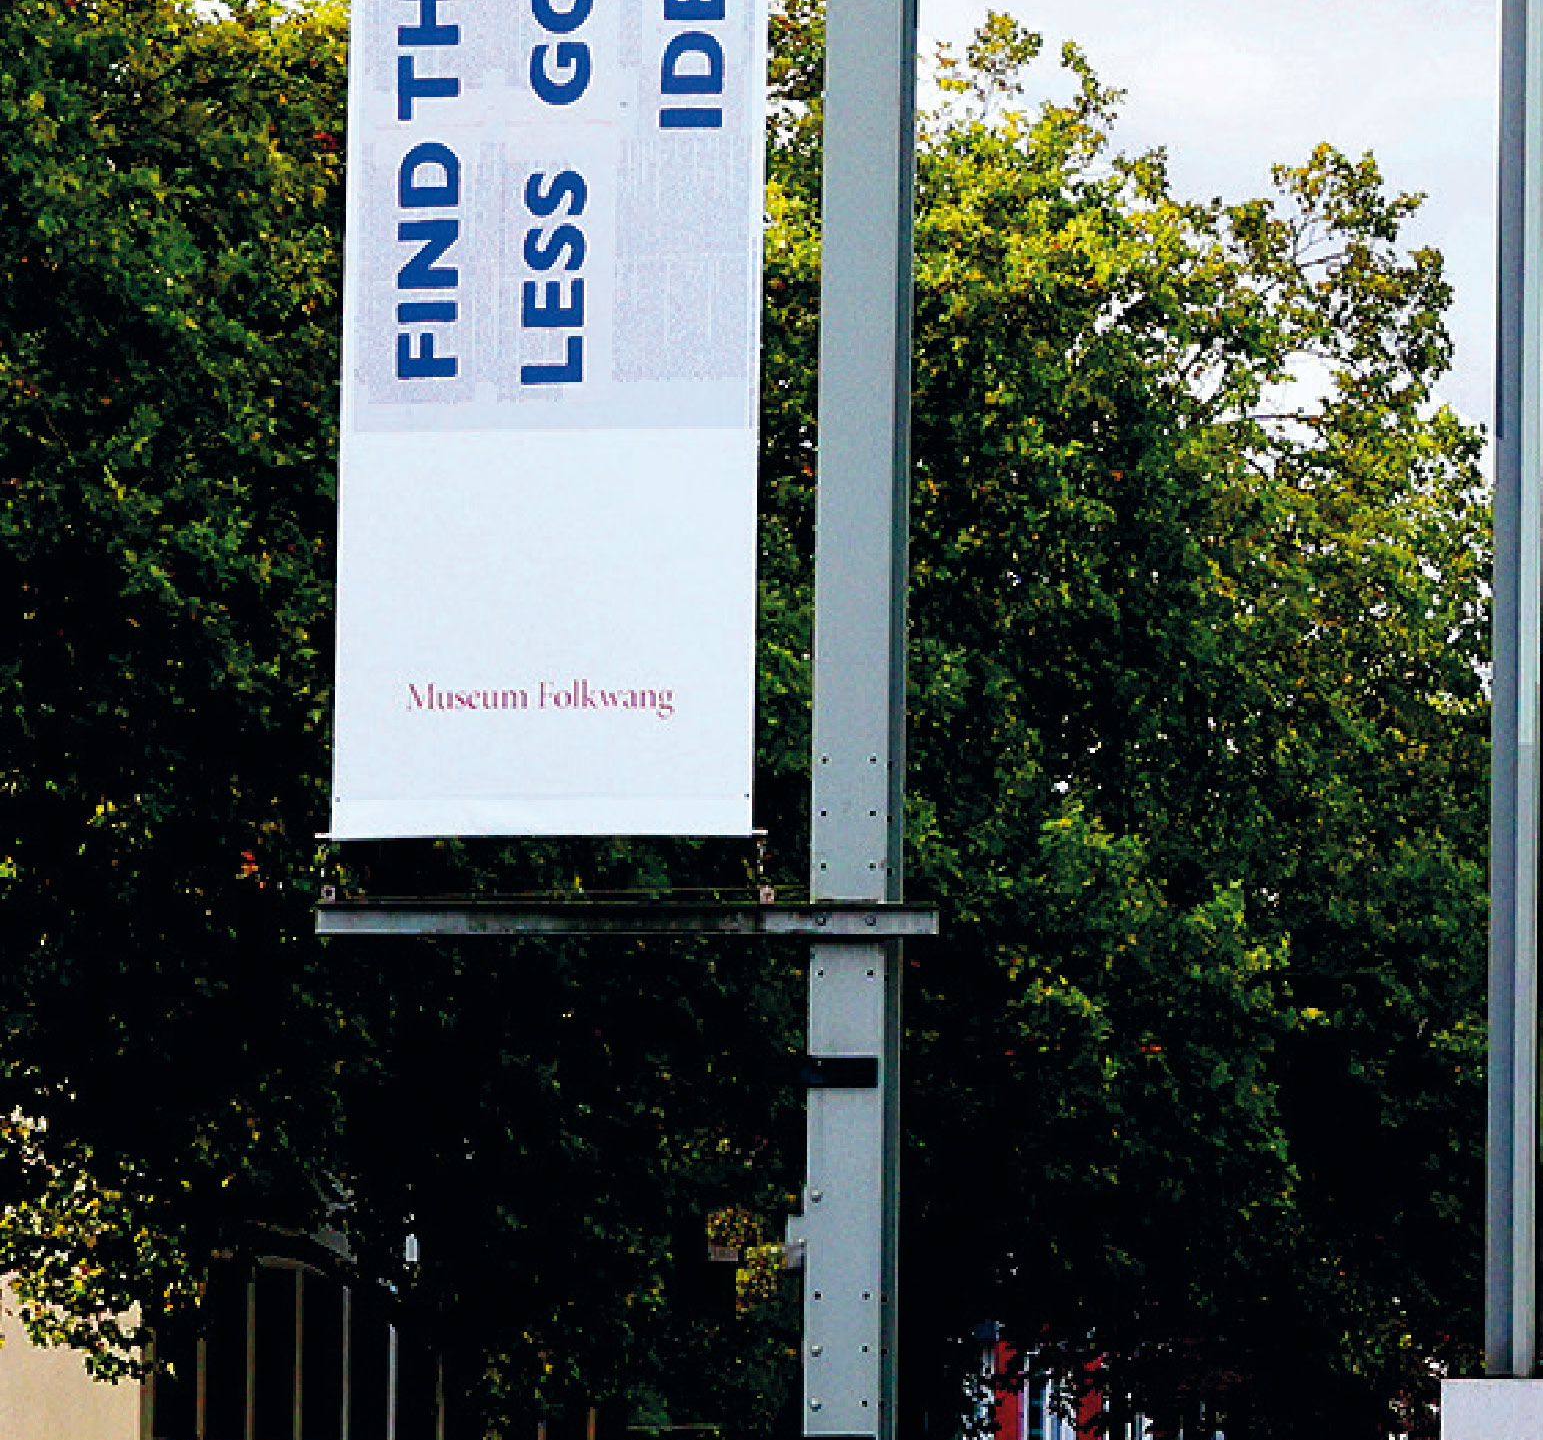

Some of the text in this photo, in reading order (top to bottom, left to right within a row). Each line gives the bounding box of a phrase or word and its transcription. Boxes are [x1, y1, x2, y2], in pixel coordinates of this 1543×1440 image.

[398, 142, 462, 382] FIND
[520, 169, 588, 387] LESS
[406, 679, 676, 720] Museum Folkwang
